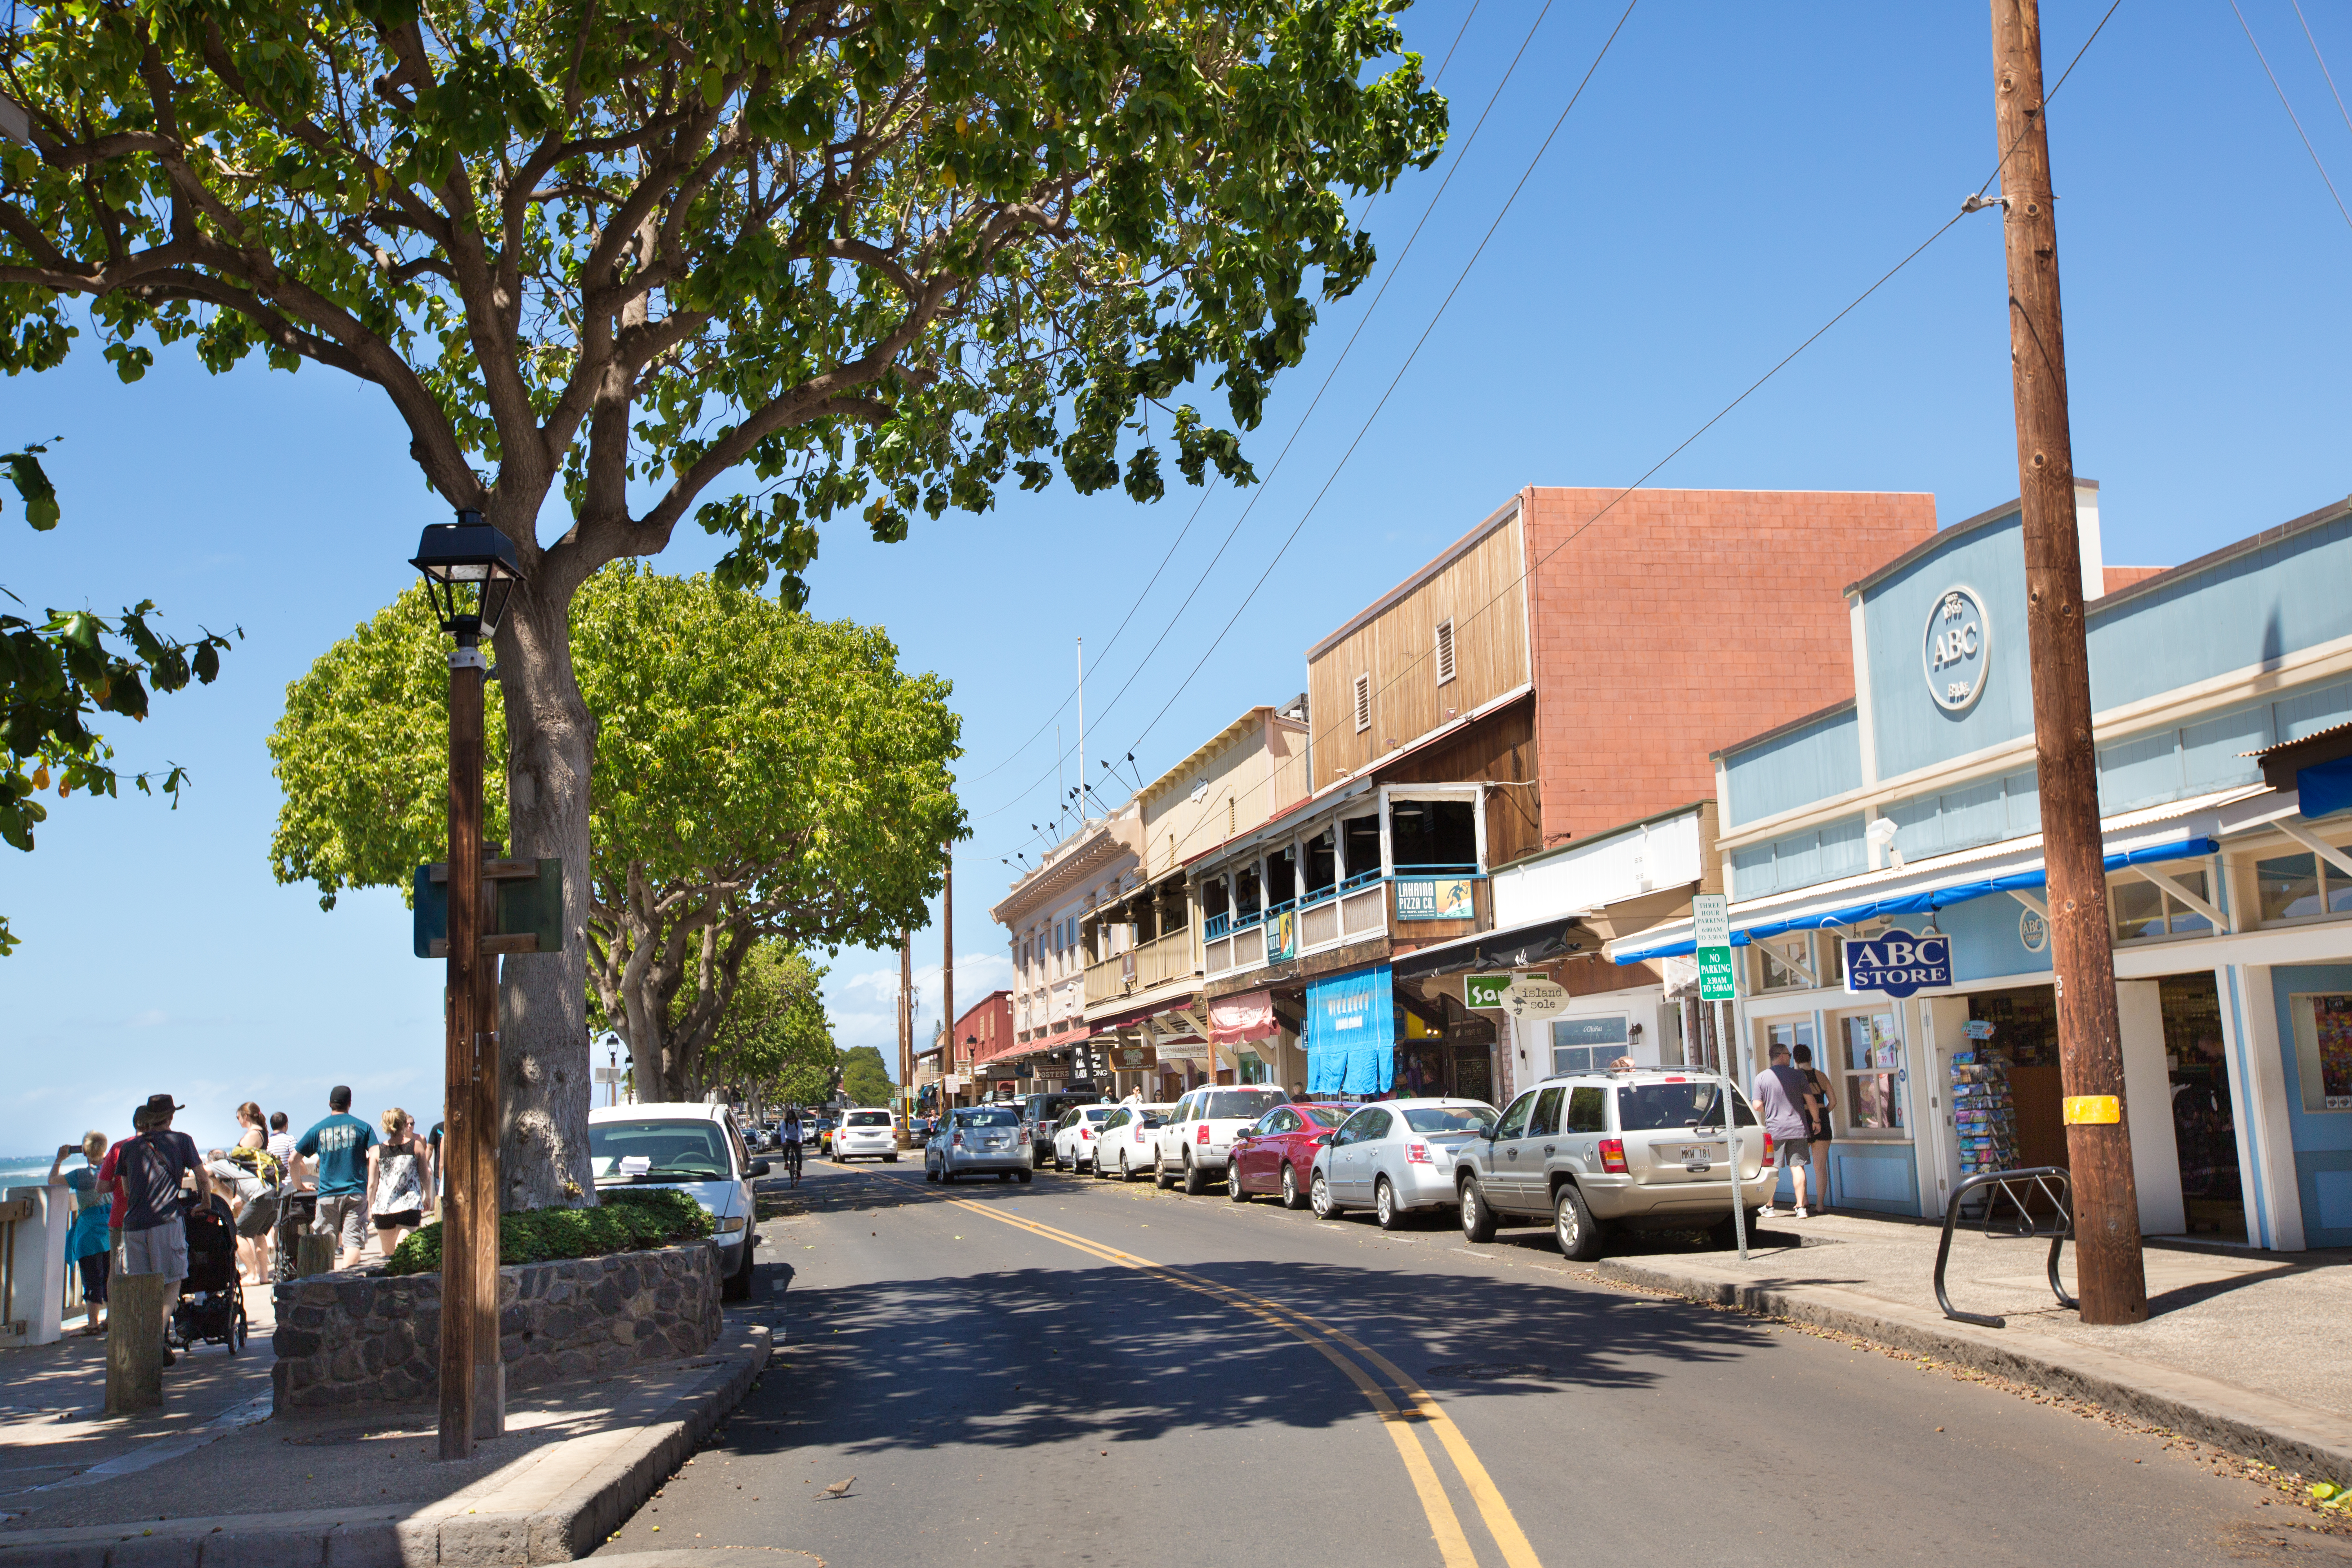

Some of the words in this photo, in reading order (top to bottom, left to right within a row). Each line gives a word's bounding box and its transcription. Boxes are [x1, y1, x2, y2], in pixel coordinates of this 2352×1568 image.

[1942, 600, 1963, 620] 1965
[1933, 621, 1978, 666] ABC
[1398, 882, 1434, 897] LAHAINA
[1399, 898, 1420, 910] PIZZA
[1423, 897, 1435, 909] CO.
[2023, 918, 2042, 934] ABC
[1709, 954, 1720, 963] NO
[1853, 939, 1944, 968] ABC
[1701, 964, 1731, 974] PARKING
[1707, 976, 1727, 984] 3:30AM
[1854, 967, 1947, 986] STORE
[1522, 988, 1563, 998] island
[1713, 984, 1733, 992] 5:00AM
[1530, 999, 1555, 1009] sole
[1036, 1071, 1069, 1079] POSTERS
[1682, 1149, 1695, 1159] MKW
[1699, 1149, 1710, 1158] 181
